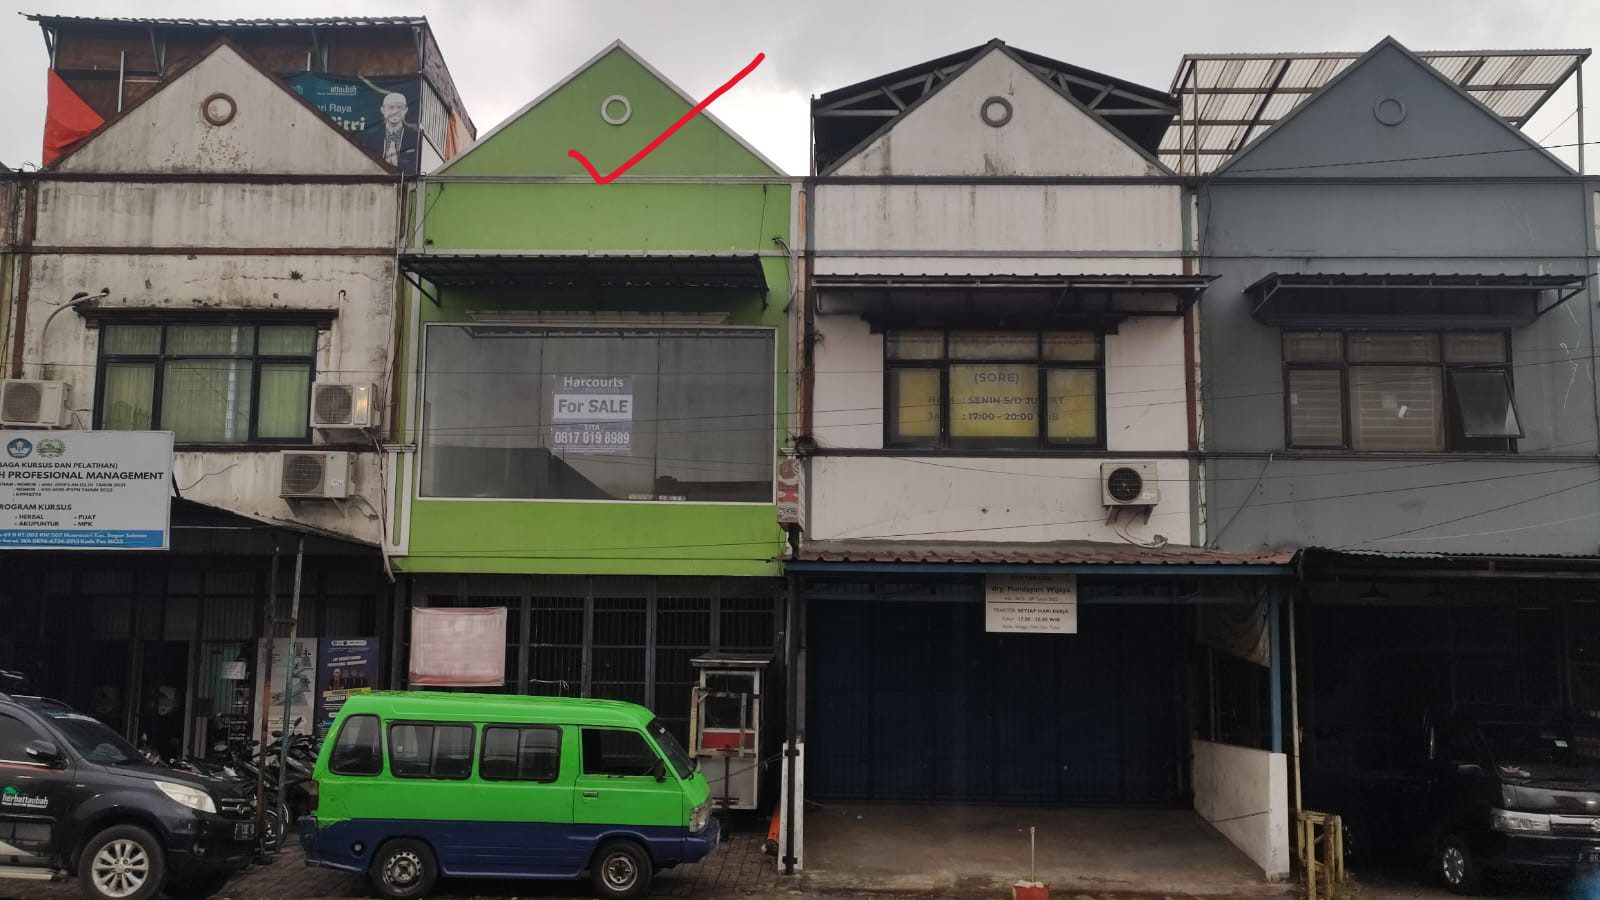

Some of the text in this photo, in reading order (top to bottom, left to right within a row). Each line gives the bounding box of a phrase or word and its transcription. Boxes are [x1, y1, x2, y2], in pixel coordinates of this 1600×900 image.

[329, 103, 352, 113] Raya
[563, 376, 624, 387] Harcourts
[974, 372, 1020, 384] (SORE)
[968, 396, 1001, 404] SENIN
[558, 399, 629, 414] For SALE
[1004, 412, 1034, 421] 20:00
[554, 431, 630, 444] 0817 019 8989
[74, 462, 118, 470] PELATIHAN)
[8, 471, 83, 479] PROFESIONAL
[86, 471, 164, 480] MANAGEMENT
